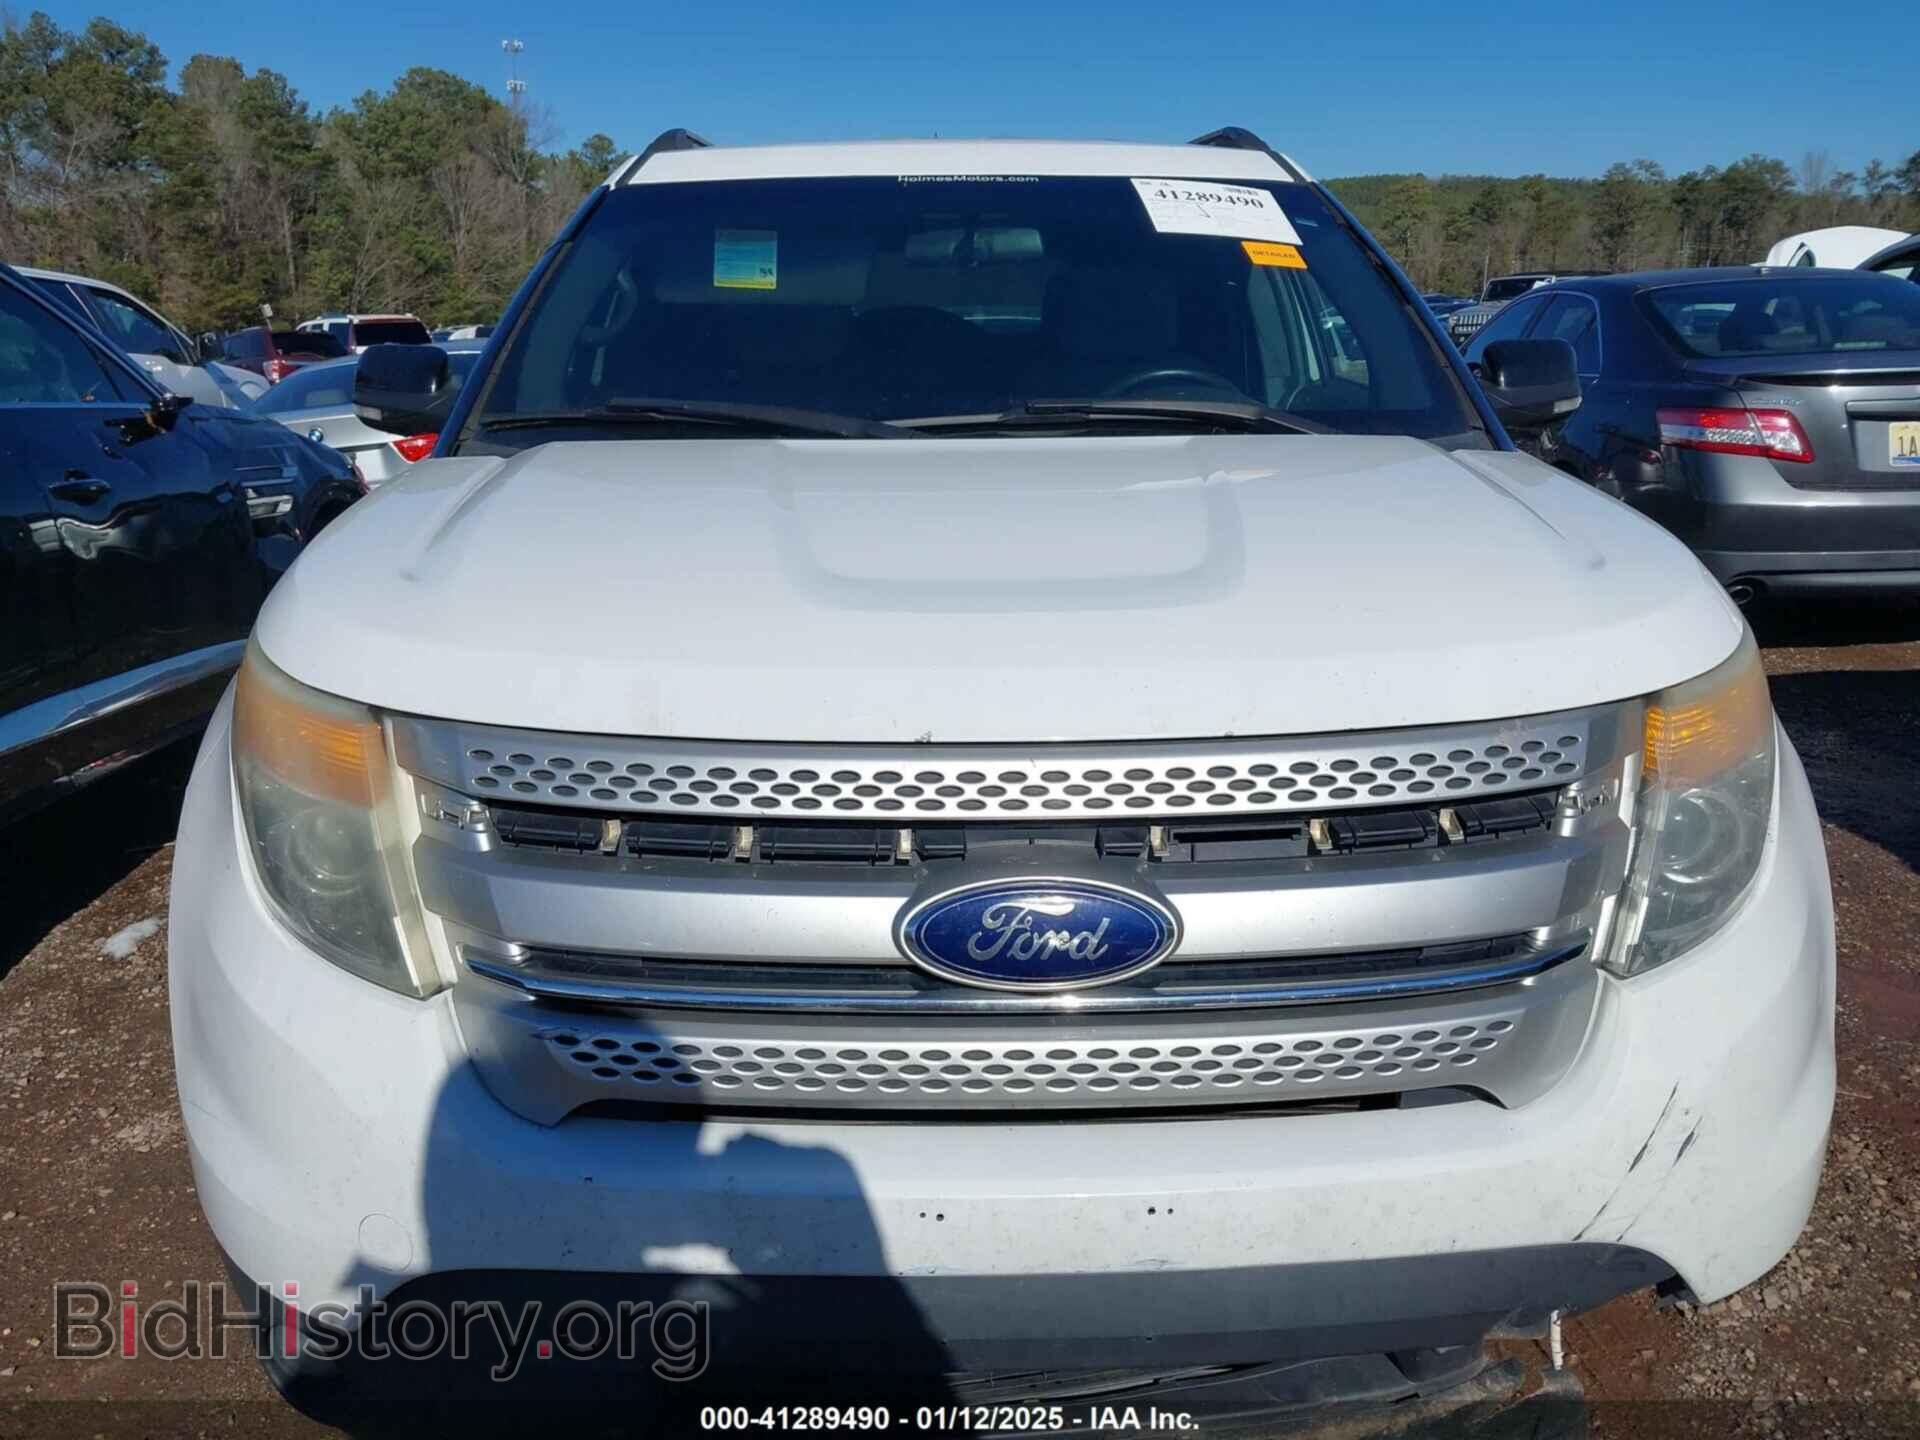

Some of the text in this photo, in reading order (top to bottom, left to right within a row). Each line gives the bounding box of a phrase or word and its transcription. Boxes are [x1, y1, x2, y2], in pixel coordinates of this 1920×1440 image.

[898, 174, 1040, 183] HolmesMotors.com
[1154, 189, 1265, 209] 41289490
[967, 895, 1111, 961] Ford
